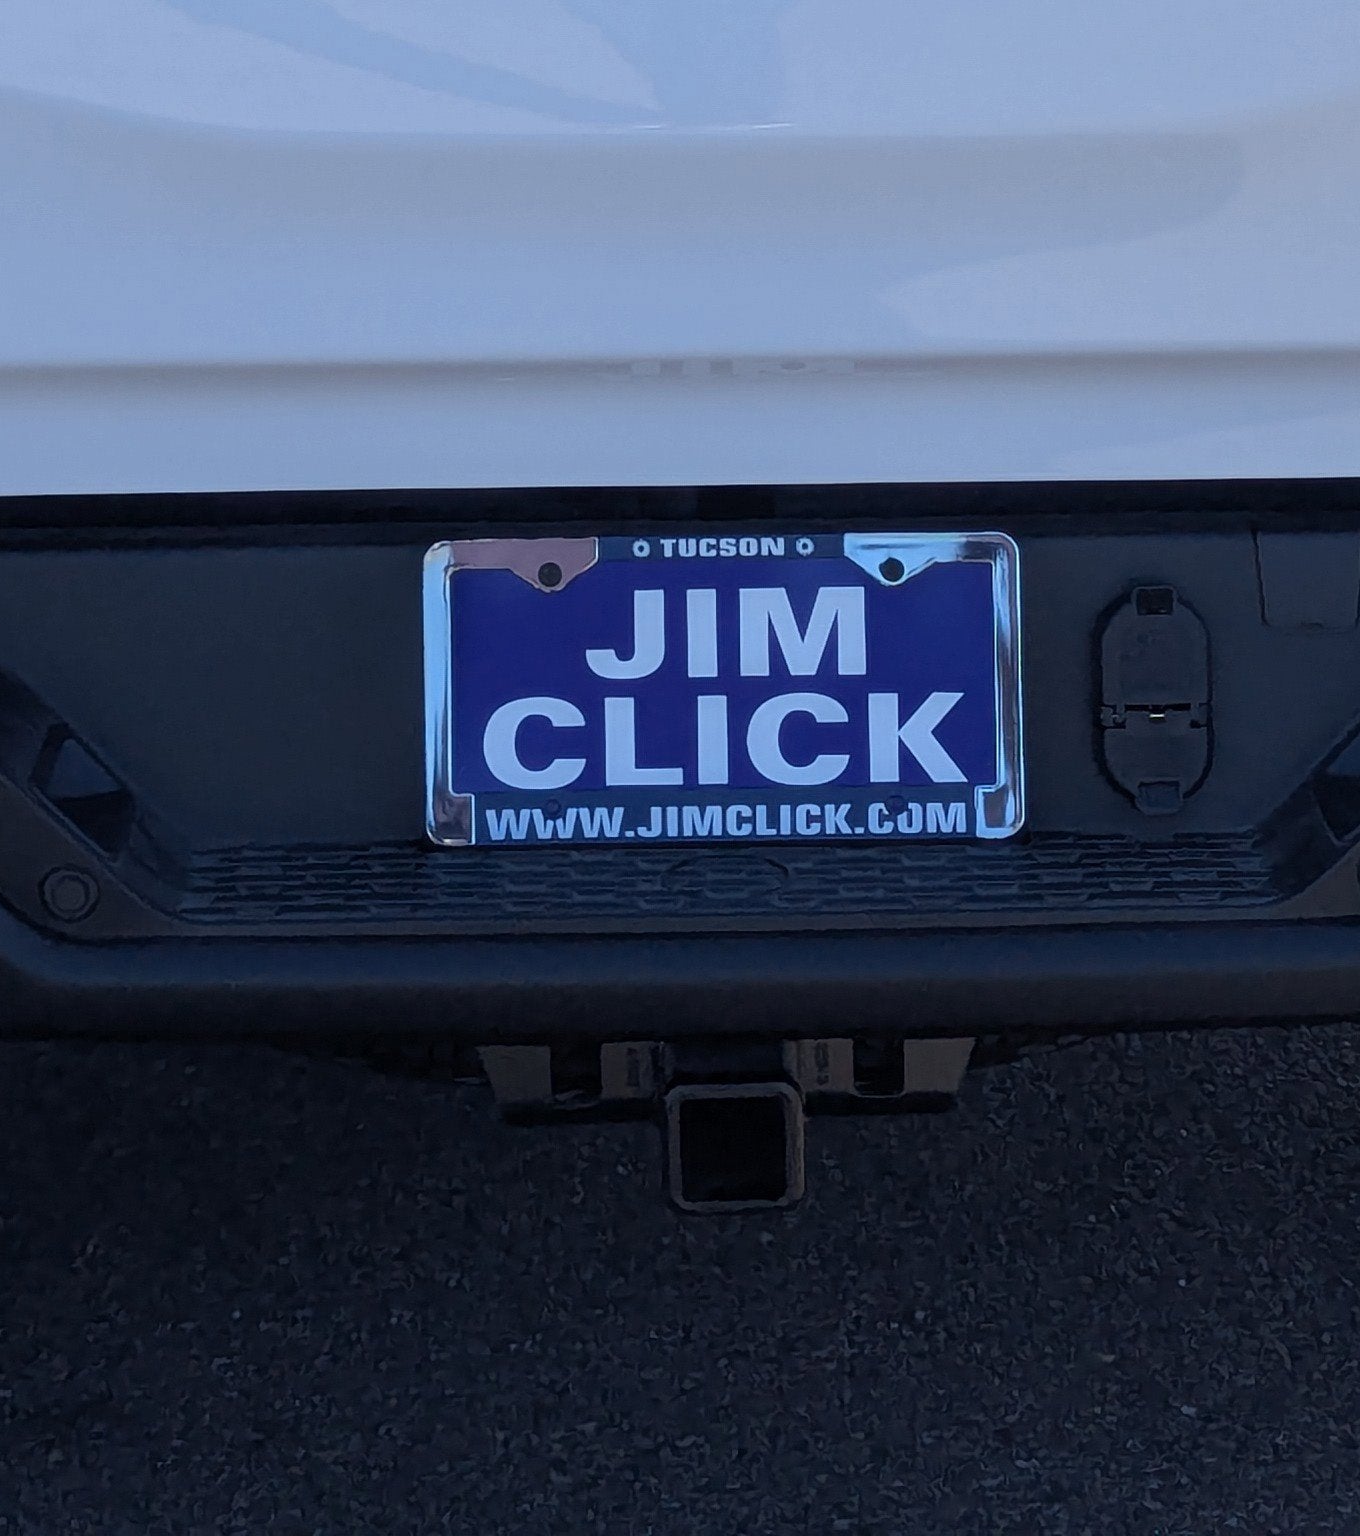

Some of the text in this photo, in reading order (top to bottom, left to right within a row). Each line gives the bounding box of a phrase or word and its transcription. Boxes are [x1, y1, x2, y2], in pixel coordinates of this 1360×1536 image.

[659, 537, 785, 558] TUCSON
[584, 586, 869, 680] JIM
[481, 691, 970, 790] CLICK
[485, 802, 967, 841] WWW.JIMCLICK.COM
